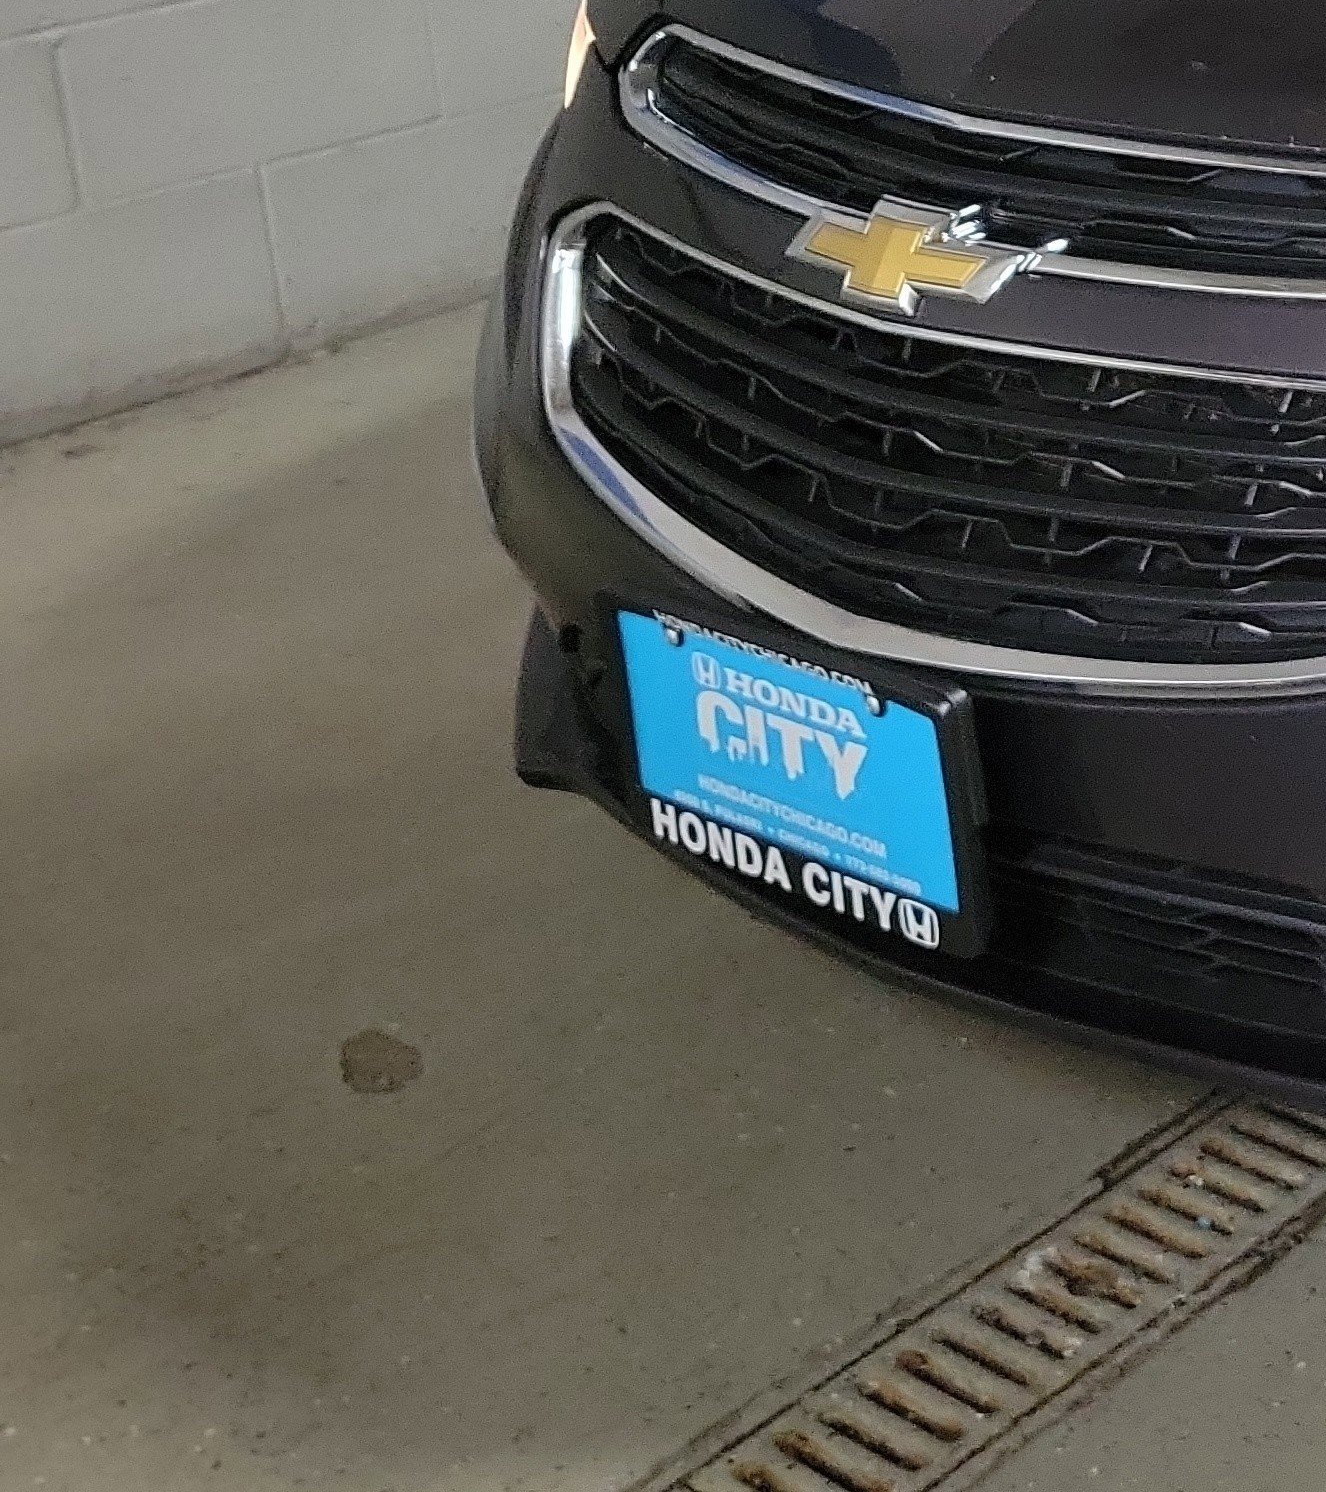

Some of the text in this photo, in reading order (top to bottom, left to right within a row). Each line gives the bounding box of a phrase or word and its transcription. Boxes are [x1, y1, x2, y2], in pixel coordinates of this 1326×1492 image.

[697, 690, 868, 799] CITY
[723, 666, 868, 740] HONDA
[651, 798, 792, 891] HONDA
[802, 861, 897, 932] CITY
